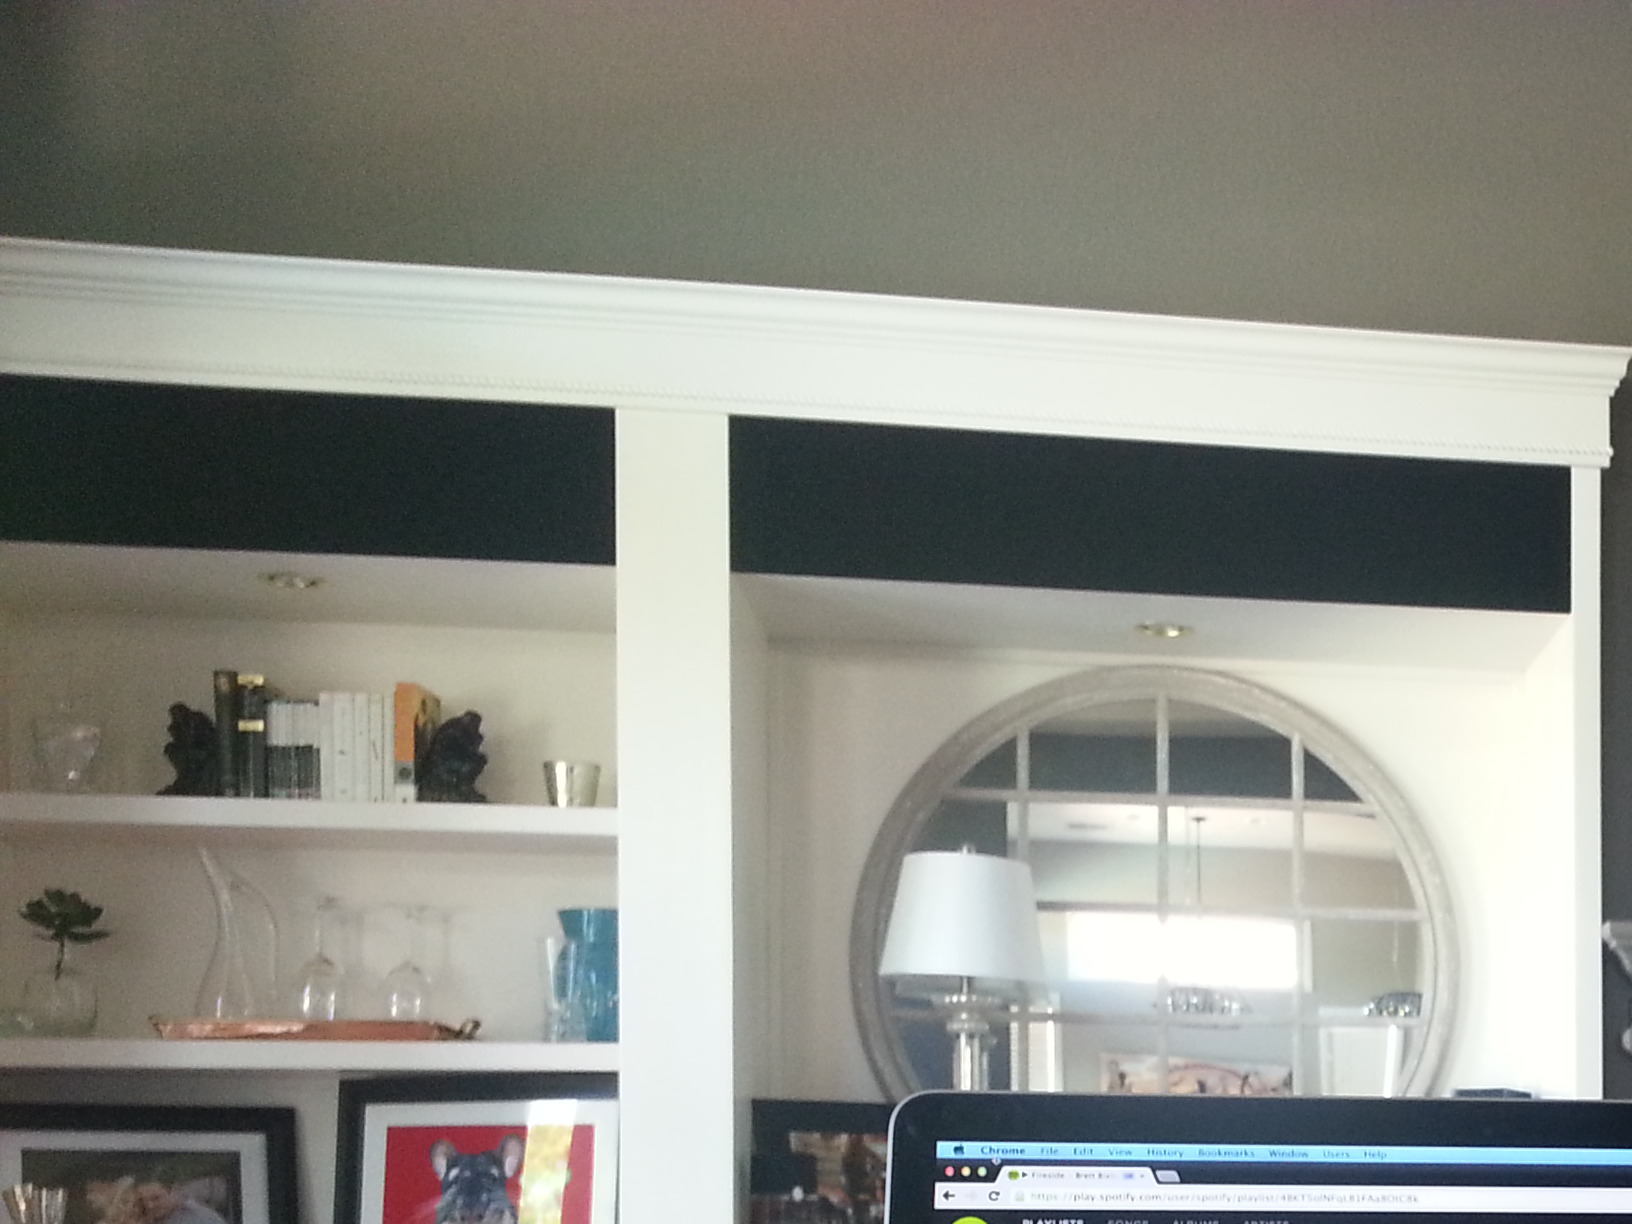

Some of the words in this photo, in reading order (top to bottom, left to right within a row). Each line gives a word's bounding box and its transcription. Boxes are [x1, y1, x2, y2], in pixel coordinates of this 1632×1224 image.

[980, 1146, 1026, 1155] Chrome
[1073, 1147, 1093, 1156] Edit
[1108, 1148, 1133, 1157] View
[1147, 1148, 1184, 1158] History
[1268, 1149, 1309, 1158] Window
